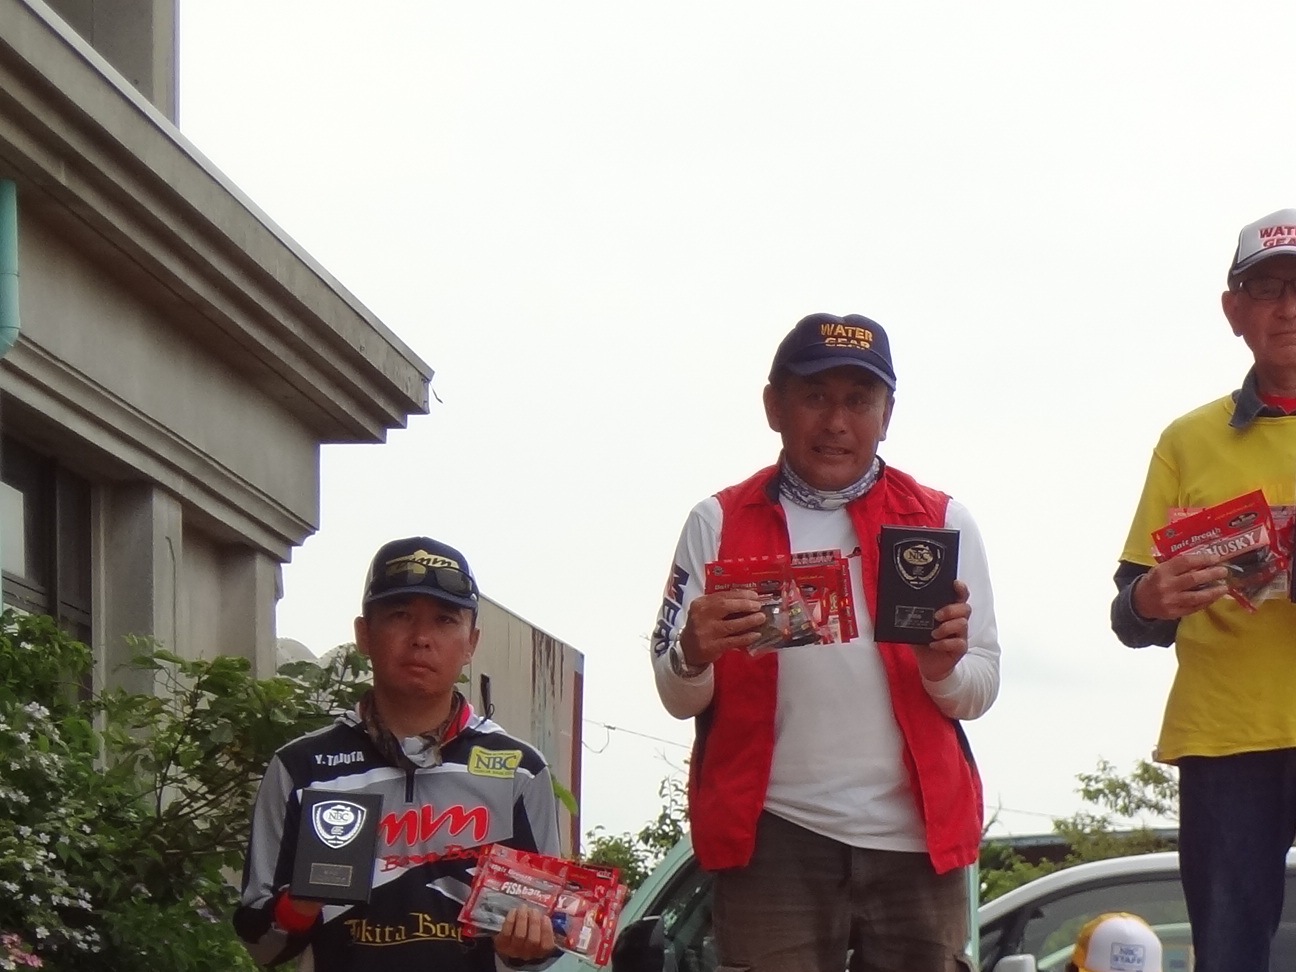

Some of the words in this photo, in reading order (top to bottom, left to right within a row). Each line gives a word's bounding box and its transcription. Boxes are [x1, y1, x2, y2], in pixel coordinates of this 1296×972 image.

[820, 323, 873, 341] WATER
[824, 337, 871, 350] GEAR
[1207, 531, 1256, 558] HUSKY
[474, 753, 517, 771] NBC
[327, 812, 350, 822] NBC
